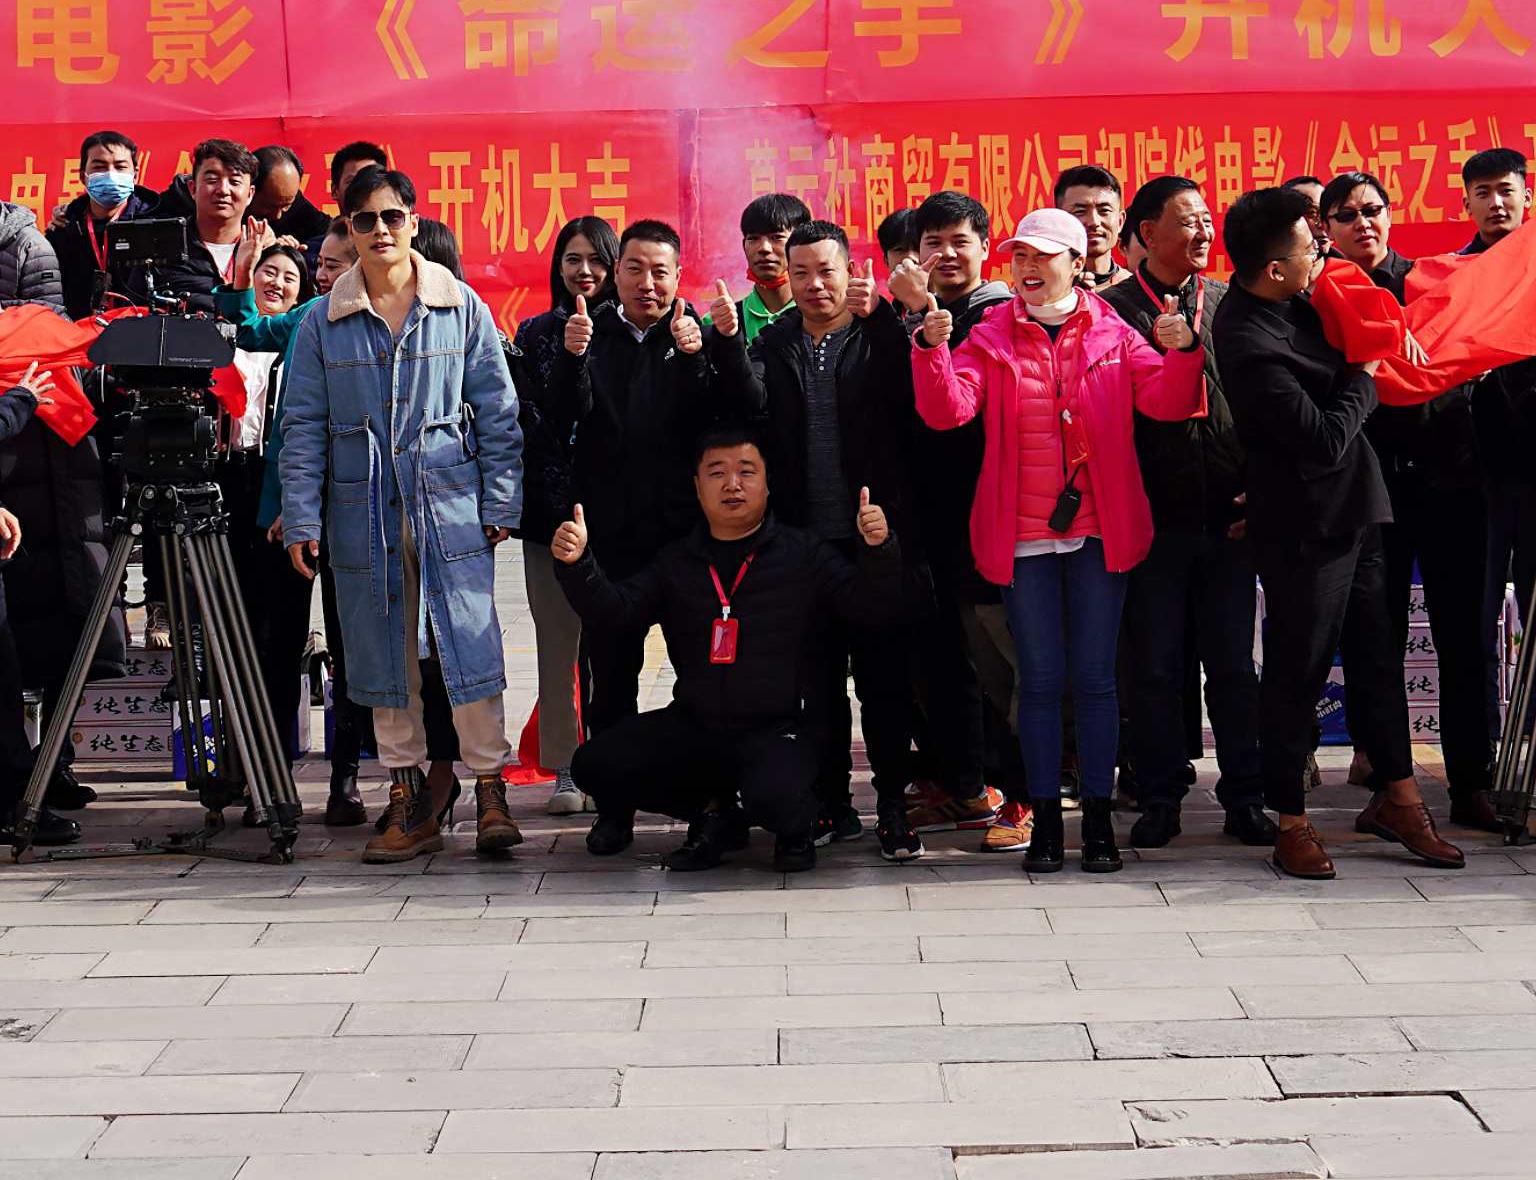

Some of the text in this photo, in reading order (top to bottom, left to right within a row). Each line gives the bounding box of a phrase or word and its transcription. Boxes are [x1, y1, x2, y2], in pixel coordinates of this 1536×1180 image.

[1406, 636, 1435, 655] 纯
[1407, 675, 1436, 695] 纯
[93, 695, 169, 715] 纯生态
[1413, 715, 1440, 734] 纯
[89, 733, 165, 753] 纯生态
